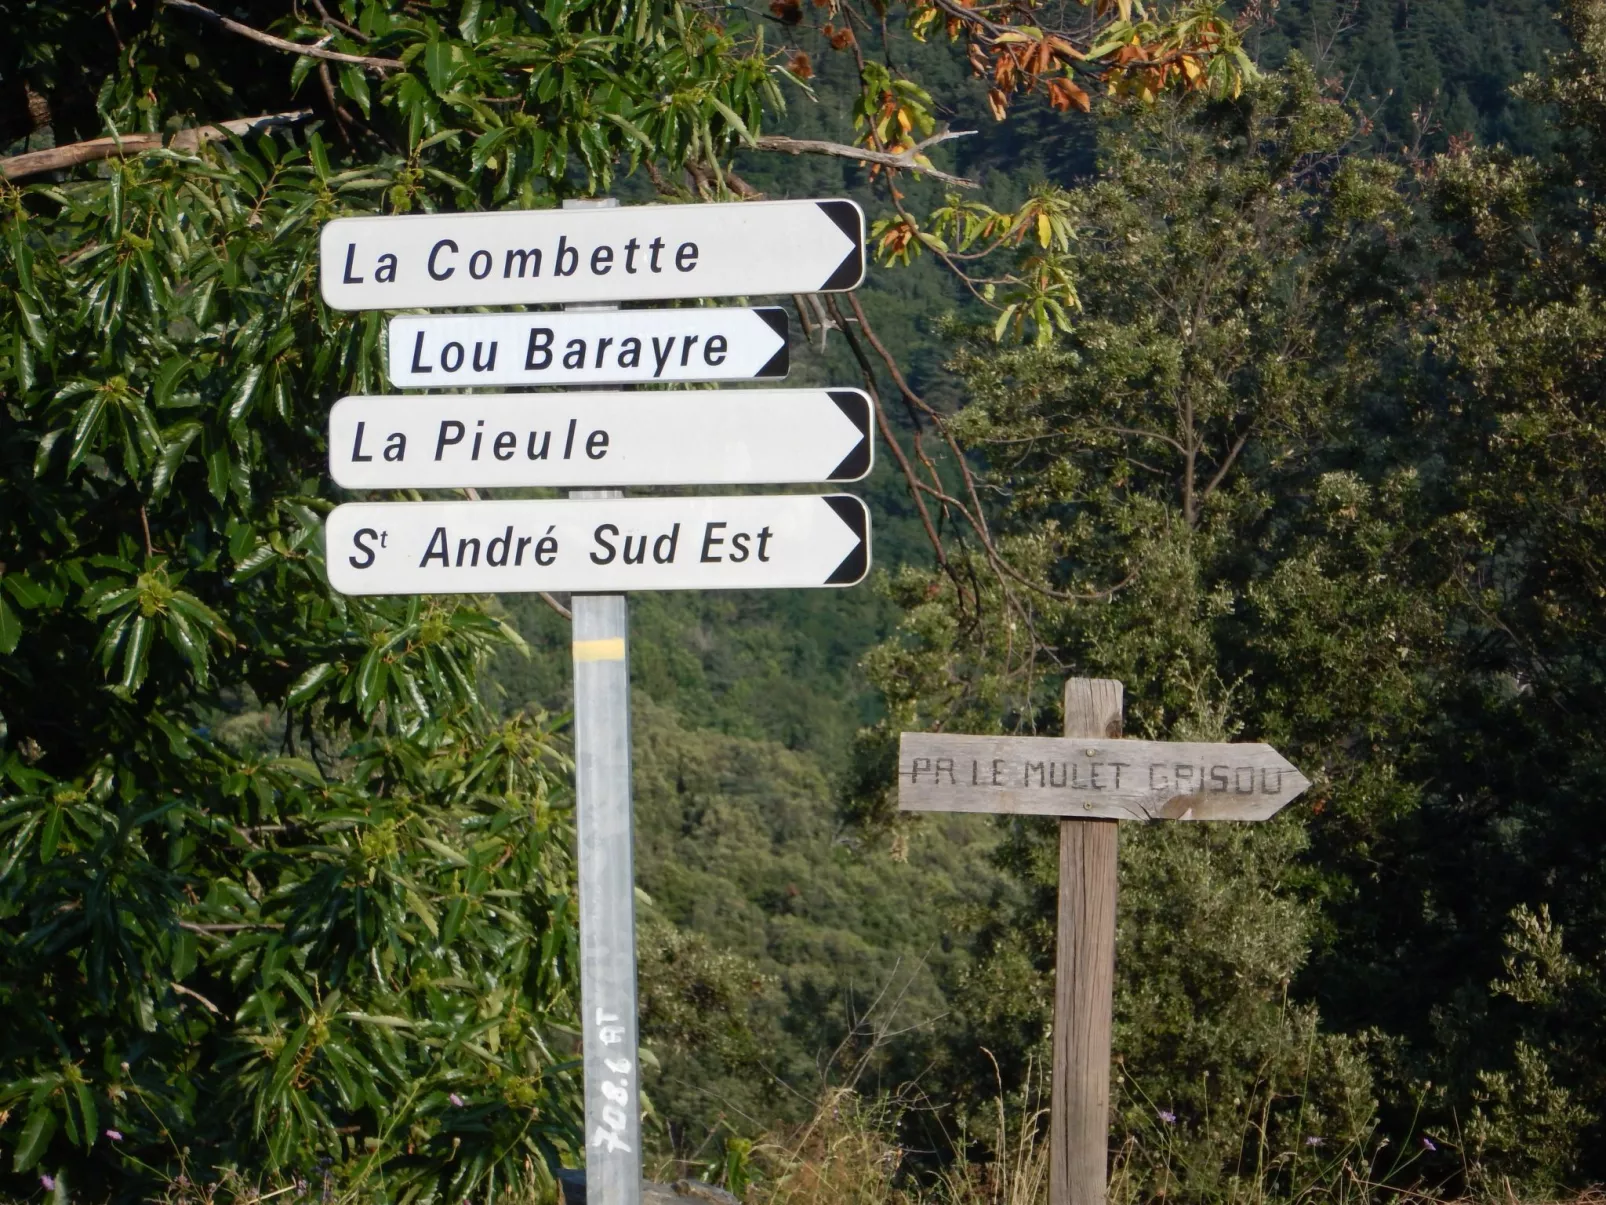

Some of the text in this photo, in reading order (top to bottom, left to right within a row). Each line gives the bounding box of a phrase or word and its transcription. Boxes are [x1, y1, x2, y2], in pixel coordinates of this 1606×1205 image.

[343, 235, 699, 285] La Combette
[410, 327, 728, 378] Lou Barayre
[351, 418, 610, 462] La Pieule
[348, 521, 773, 570] St André Sud Est
[911, 757, 957, 785] PR
[1023, 760, 1131, 790] MULET
